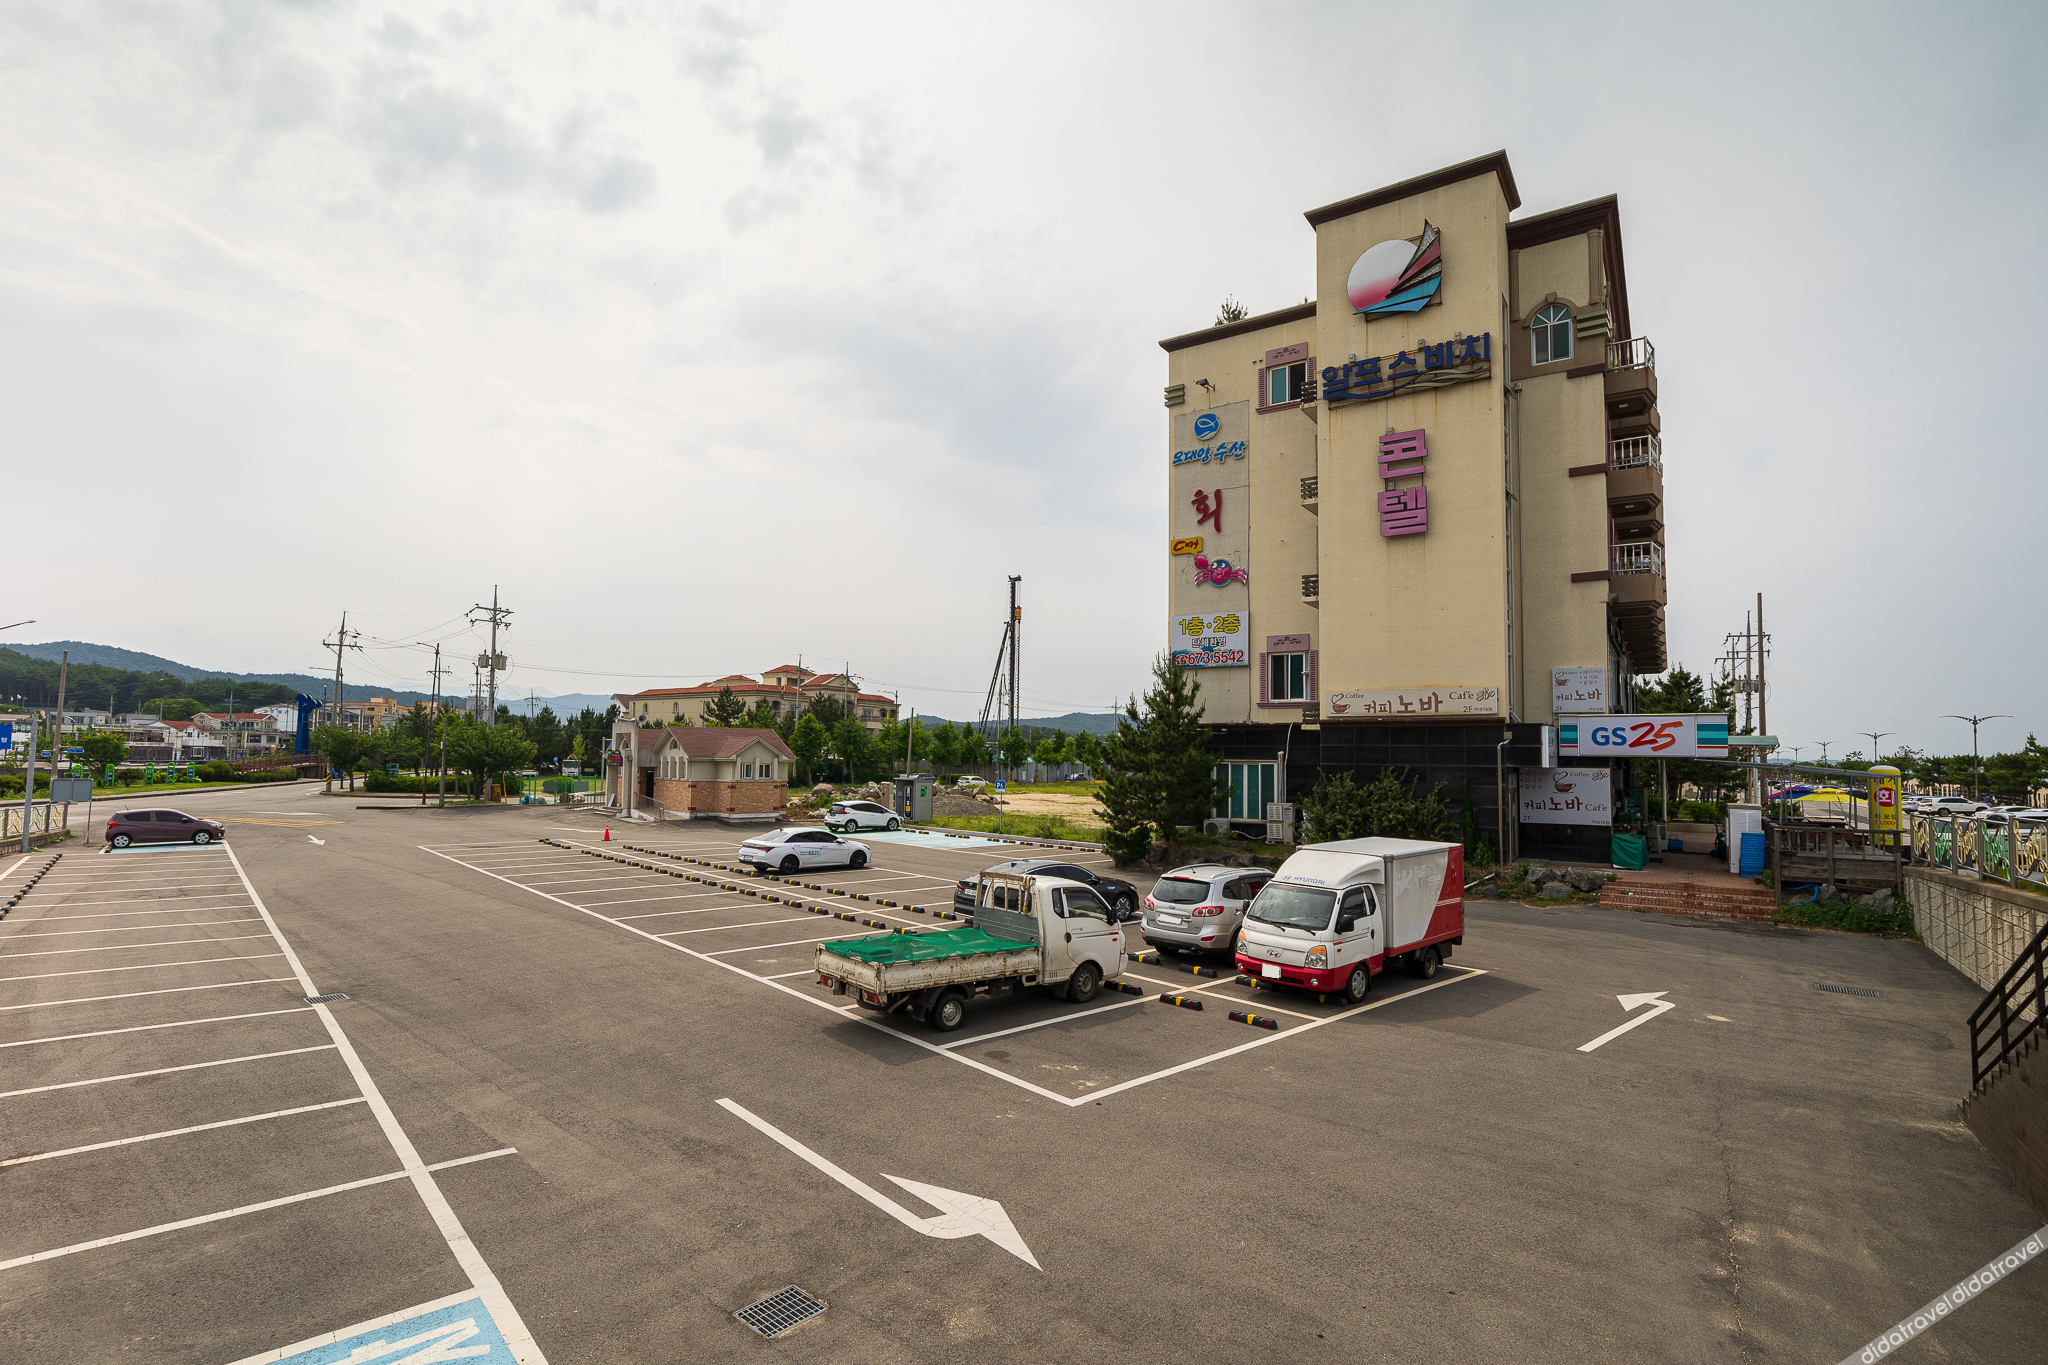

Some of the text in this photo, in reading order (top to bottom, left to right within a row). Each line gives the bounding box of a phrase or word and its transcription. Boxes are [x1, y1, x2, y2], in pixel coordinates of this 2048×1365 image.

[1321, 331, 1491, 401] 알프스비치
[1172, 440, 1247, 466] 오대양 수산
[1378, 429, 1428, 537] 콘텔
[1191, 488, 1222, 533] 회
[1188, 650, 1244, 665] 673.5542
[1364, 691, 1443, 714] 커피 노바
[1556, 688, 1602, 701] 커피 노바
[1462, 705, 1473, 713] 2F
[1591, 720, 1684, 752] GS25
[1523, 799, 1546, 810] 커피
[1548, 795, 1583, 812] 노바
[1877, 789, 1895, 805] 회
[1293, 876, 1326, 886] HYUNDAI
